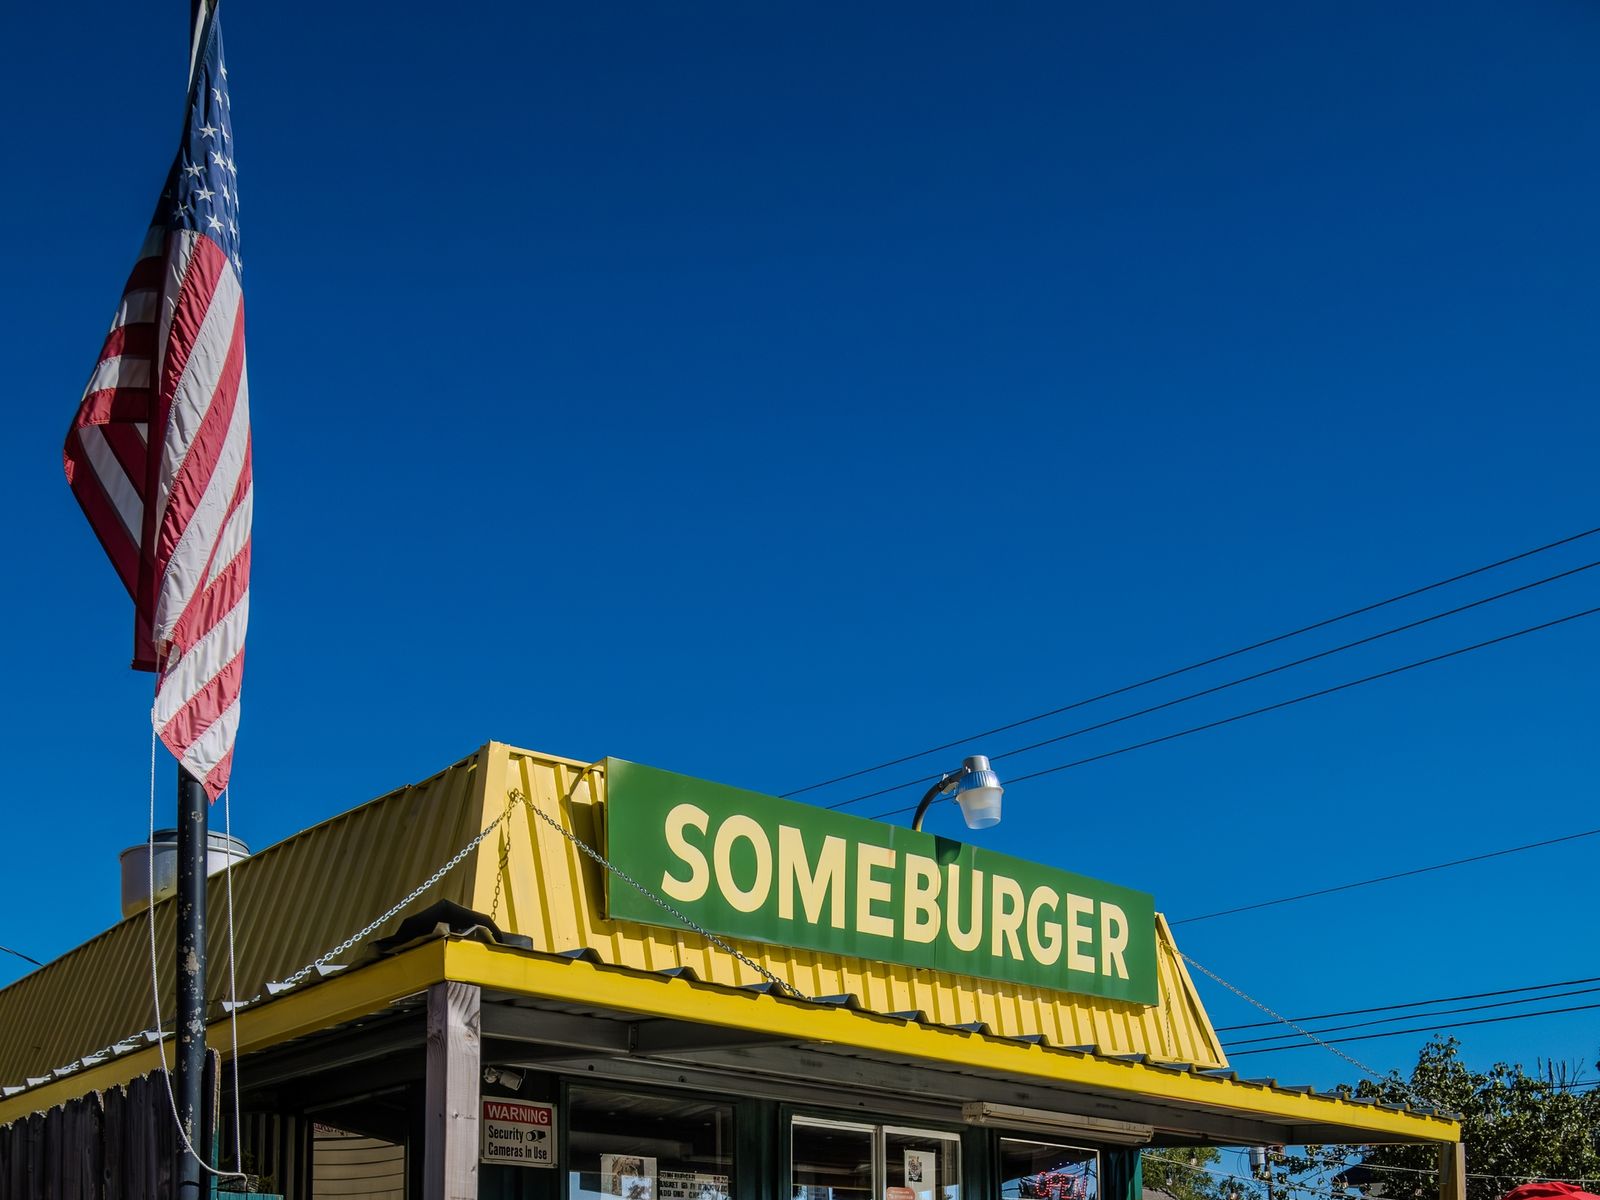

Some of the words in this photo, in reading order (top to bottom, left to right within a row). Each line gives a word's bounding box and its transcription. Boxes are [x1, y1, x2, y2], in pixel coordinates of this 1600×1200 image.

[661, 802, 1130, 981] SOMEBURGER
[487, 1104, 549, 1123] WARNING
[488, 1125, 524, 1143] Security
[488, 1142, 523, 1157] Cameras
[525, 1145, 532, 1158] In
[533, 1146, 548, 1160] Use
[1036, 1171, 1087, 1200] OPEN
